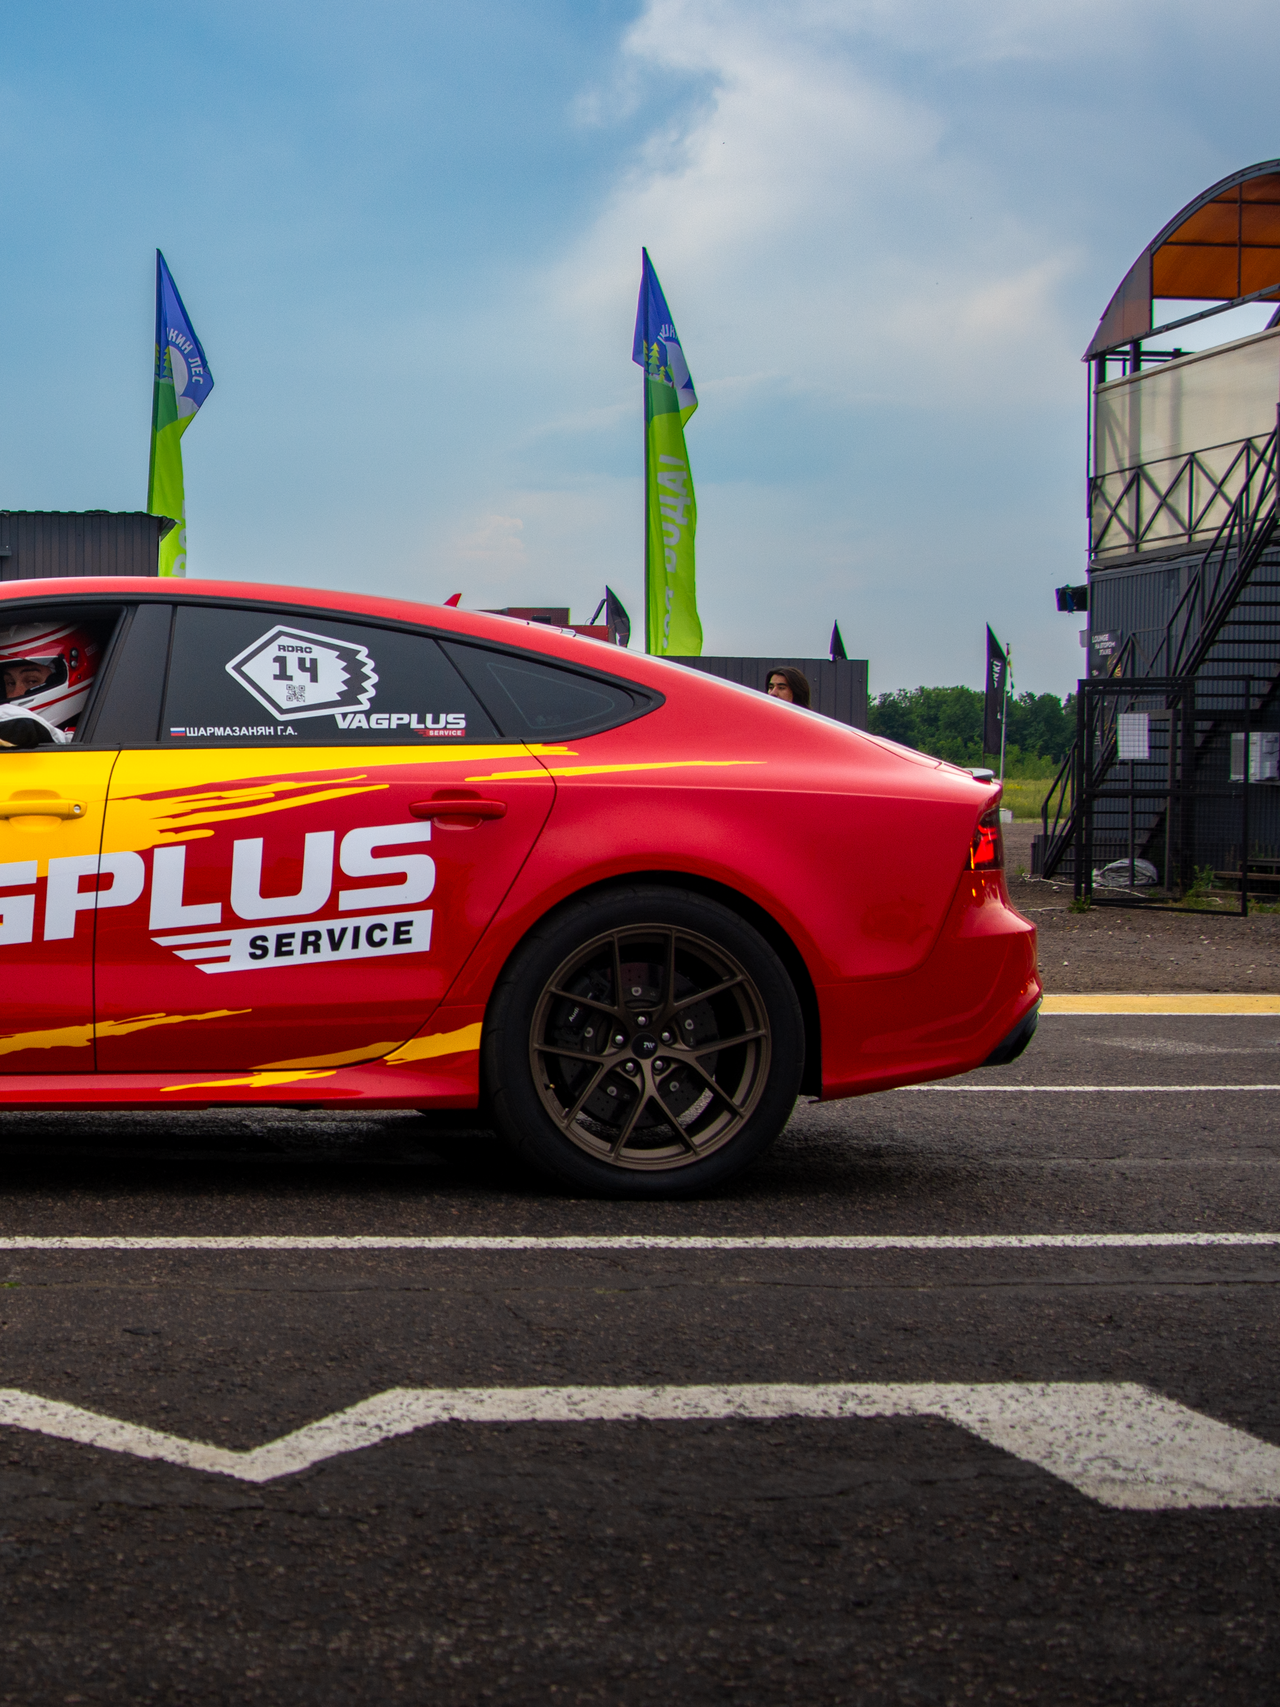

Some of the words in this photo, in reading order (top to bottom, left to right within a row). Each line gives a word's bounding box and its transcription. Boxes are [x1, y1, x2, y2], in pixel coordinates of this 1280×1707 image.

[166, 327, 194, 354] КИН
[188, 357, 204, 385] ЛЕС
[277, 644, 313, 654] RDRC
[273, 655, 319, 684] 14
[186, 726, 274, 737] ШАРМАЗАНЯН
[277, 726, 298, 736] Г.А.
[334, 713, 466, 729] VAGPLUS
[248, 919, 415, 961] SERVICE
